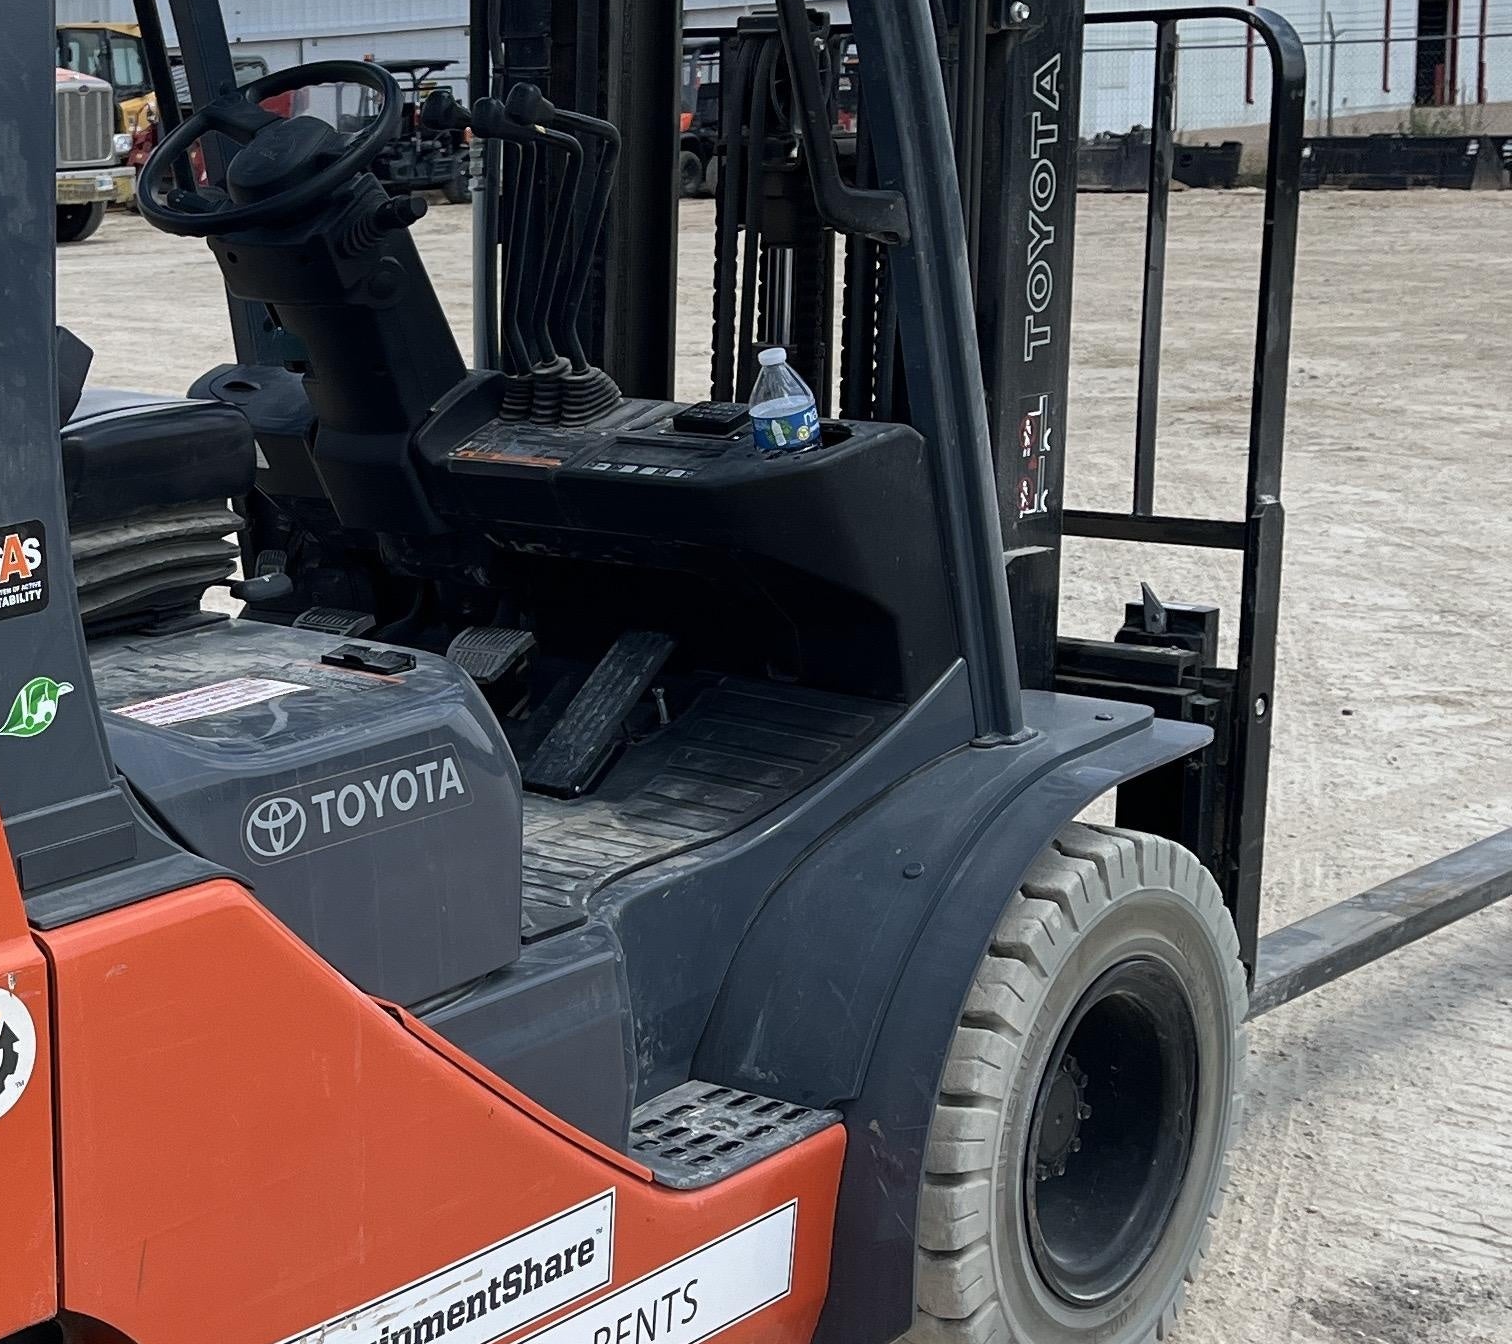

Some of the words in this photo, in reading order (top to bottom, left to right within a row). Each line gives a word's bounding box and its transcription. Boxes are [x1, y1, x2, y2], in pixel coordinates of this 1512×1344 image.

[1024, 53, 1061, 361] TOYOTA
[12, 585, 20, 593] OF
[21, 581, 42, 591] ACTIVE
[311, 757, 465, 834] TOYOTA
